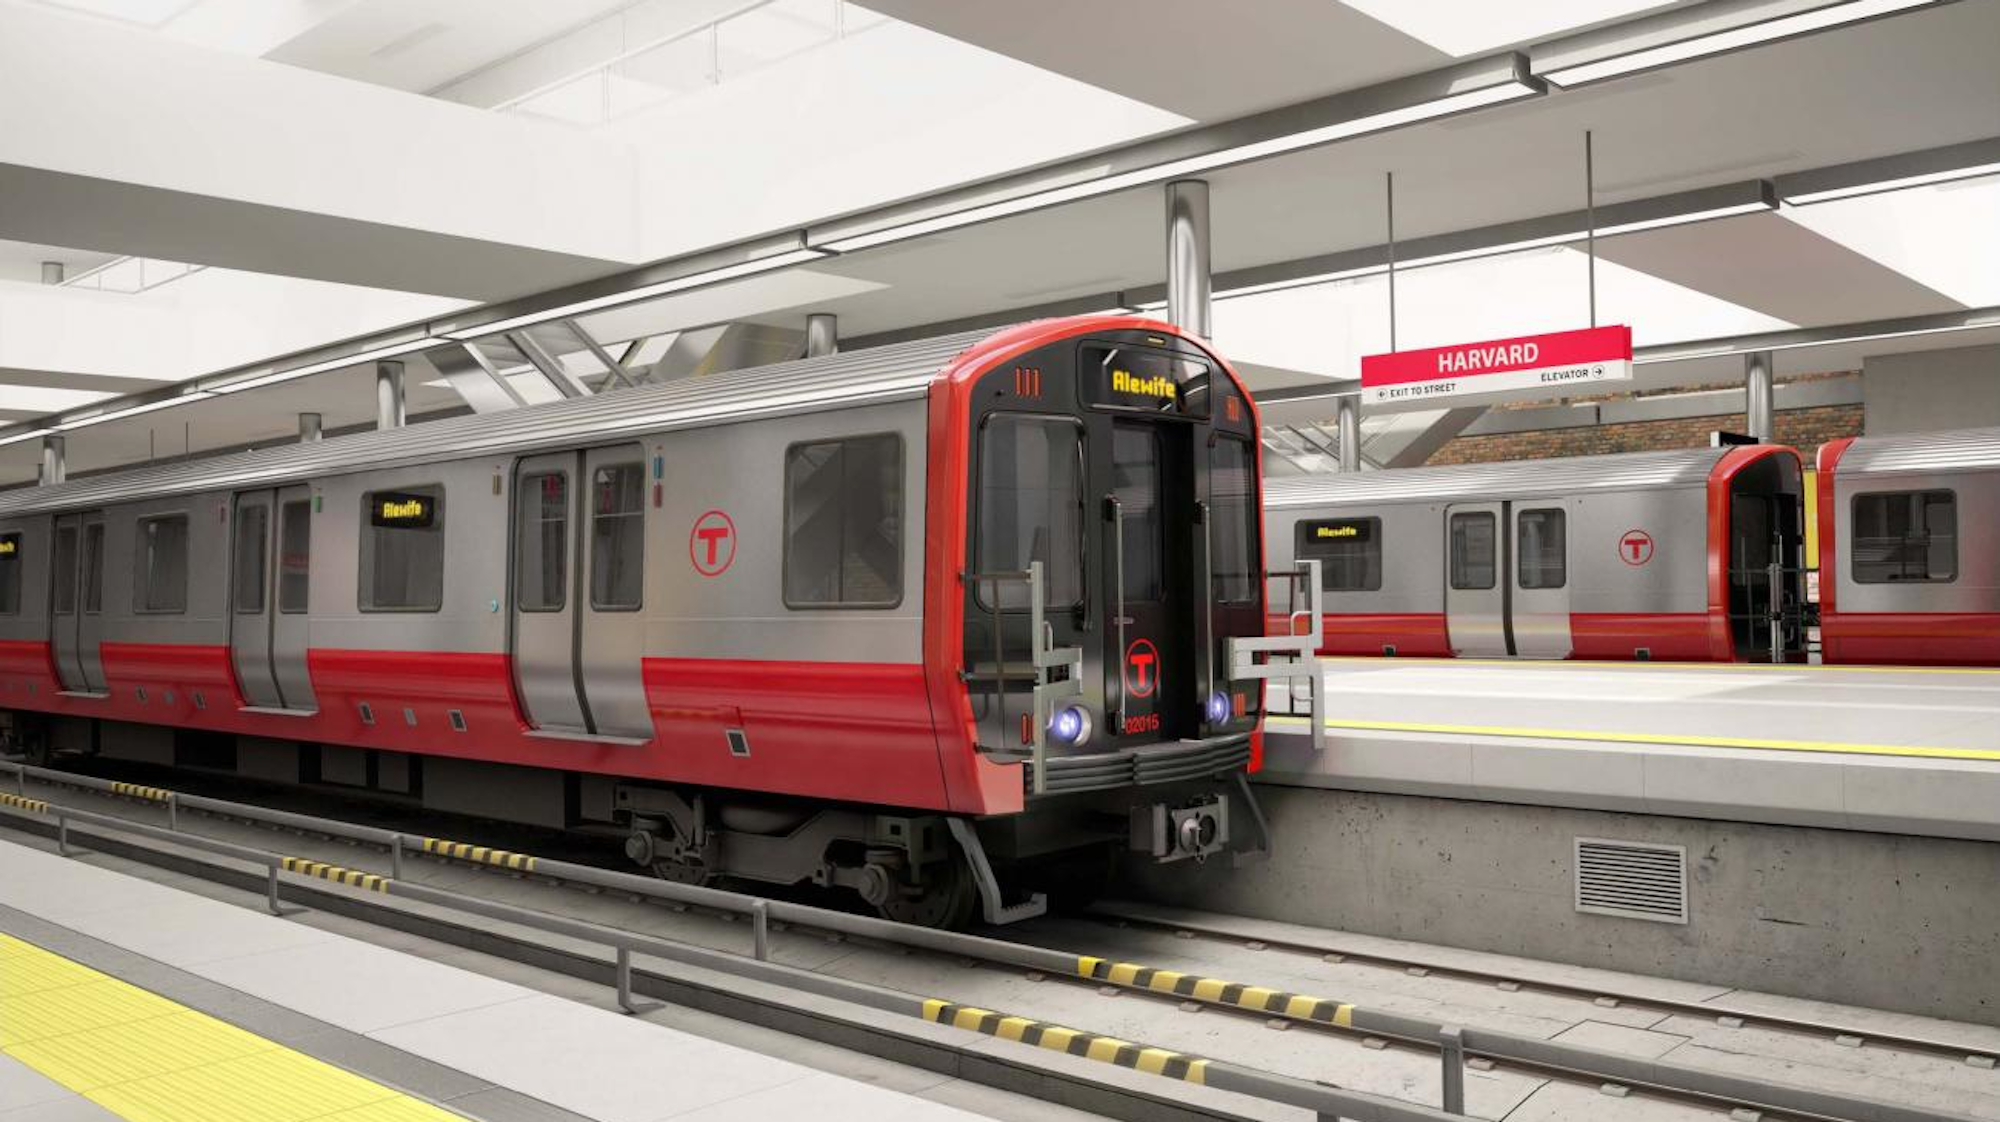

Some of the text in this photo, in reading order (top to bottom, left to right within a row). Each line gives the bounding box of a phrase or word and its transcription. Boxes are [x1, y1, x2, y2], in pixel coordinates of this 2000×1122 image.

[1438, 343, 1539, 373] HARVARD
[1112, 369, 1177, 399] Alewife
[1541, 369, 1588, 382] ELEVATOR
[1390, 383, 1456, 398] EXIT TO STREET
[383, 500, 422, 518] Alewife
[1125, 714, 1159, 734] 02015
